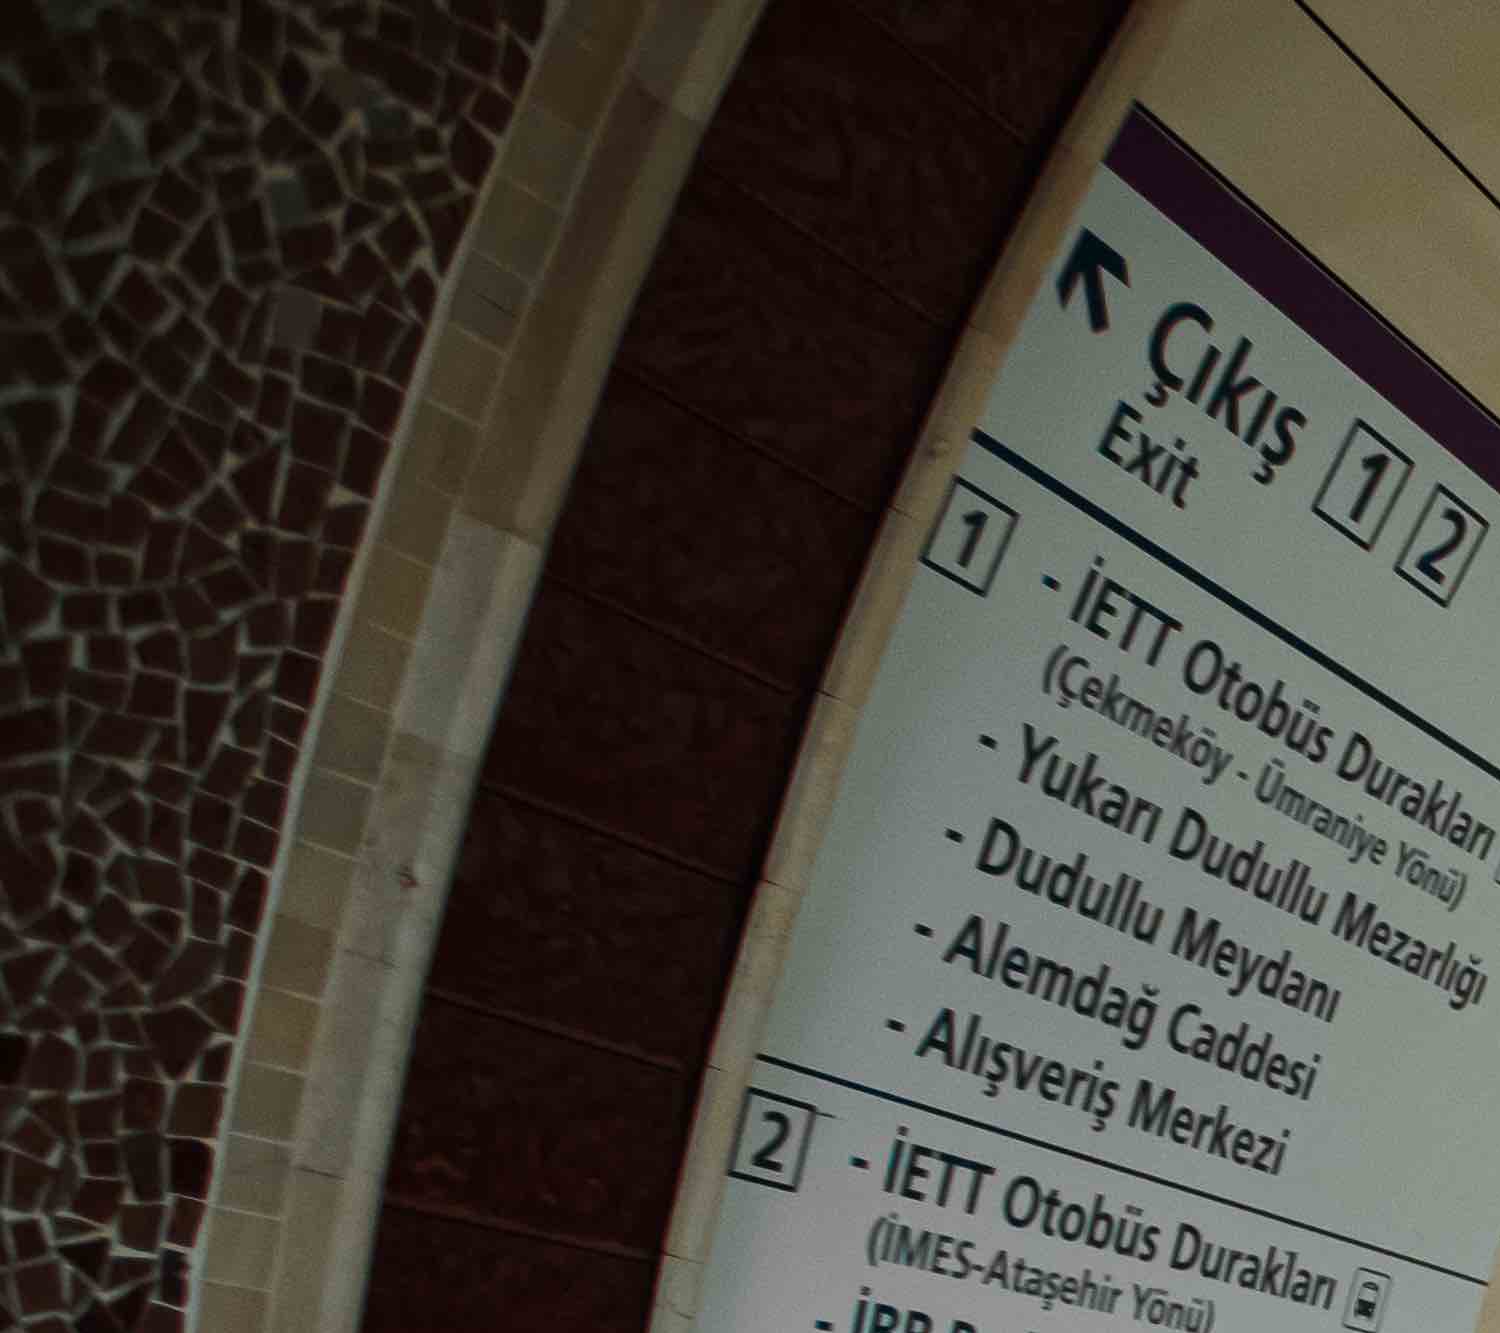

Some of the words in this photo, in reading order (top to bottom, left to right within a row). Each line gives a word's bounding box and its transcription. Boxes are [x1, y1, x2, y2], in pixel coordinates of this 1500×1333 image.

[1097, 401, 1199, 510] Exit
[1144, 301, 1307, 485] Çıkış
[1351, 453, 1392, 523] 1
[1415, 508, 1467, 584] 2
[961, 510, 989, 568] 1
[1069, 556, 1183, 667] İETT
[1183, 640, 1336, 766] Otobüs
[1336, 732, 1496, 860] Durakları
[1042, 644, 1233, 785] (Çekmeköy
[1255, 759, 1387, 865] Ümraniye
[1394, 841, 1468, 912] Yönü)
[976, 818, 1166, 945] Dudullu
[1171, 908, 1342, 1024] Meydanı
[1019, 723, 1164, 844] Yukarı
[1168, 807, 1331, 926] Dudullu
[1332, 892, 1489, 1010] Mezarlığı
[915, 1008, 1119, 1131] Alışveriş
[1128, 1080, 1291, 1176] Merkezi
[942, 914, 1158, 1051] Alemdağ
[1167, 1003, 1322, 1101] Caddesi
[751, 1110, 789, 1172] 2
[883, 1126, 996, 1215] İETT
[1003, 1176, 1160, 1256] Otobüs
[1170, 1223, 1338, 1310] Durakları
[867, 1213, 1122, 1315] (İMES-Ataşehir
